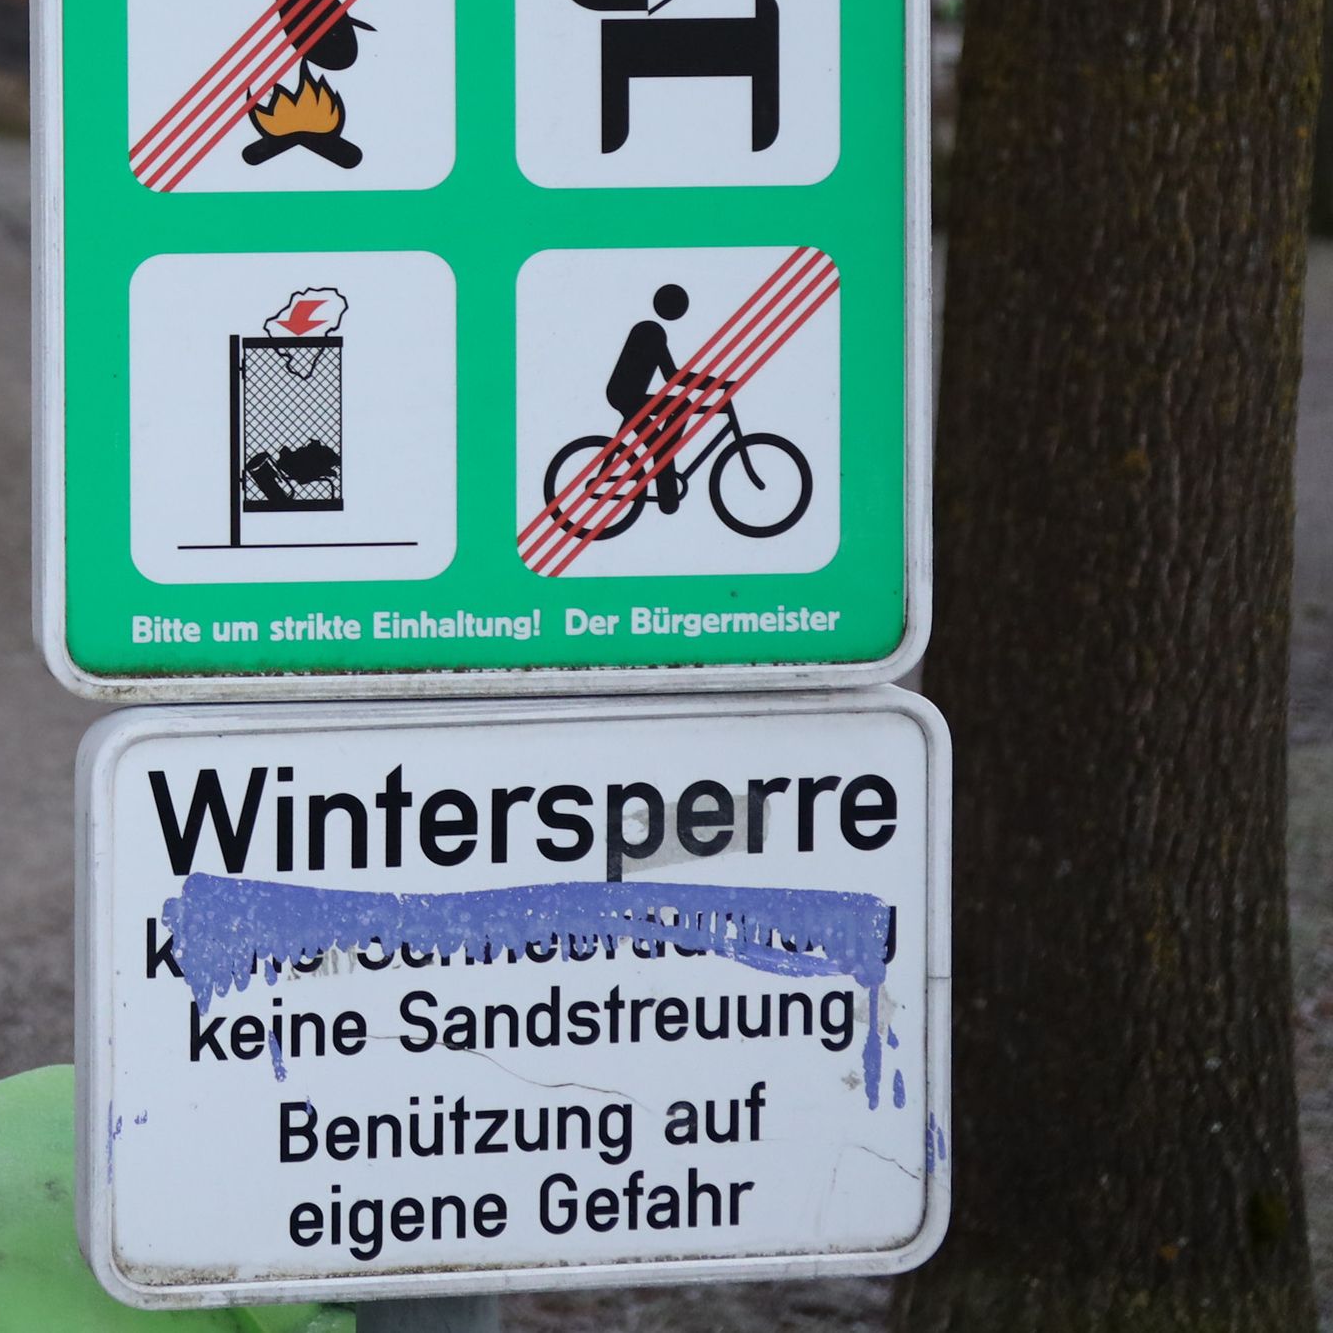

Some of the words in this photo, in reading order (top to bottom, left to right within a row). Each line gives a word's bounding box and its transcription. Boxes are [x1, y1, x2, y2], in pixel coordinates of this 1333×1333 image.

[132, 615, 201, 644] Bitte
[212, 621, 259, 643] um
[270, 612, 361, 642] strikte
[373, 609, 541, 641] Einhaltung!
[565, 608, 620, 636] Der
[631, 605, 840, 637] Bürgermeister
[148, 764, 898, 882] Wintersperre
[189, 997, 367, 1062] keine
[399, 985, 854, 1053] Sandstreuung
[278, 1096, 632, 1165] Benützung
[664, 1081, 766, 1146] auf
[289, 1184, 507, 1261] eigene
[539, 1169, 755, 1235] Gefahr
